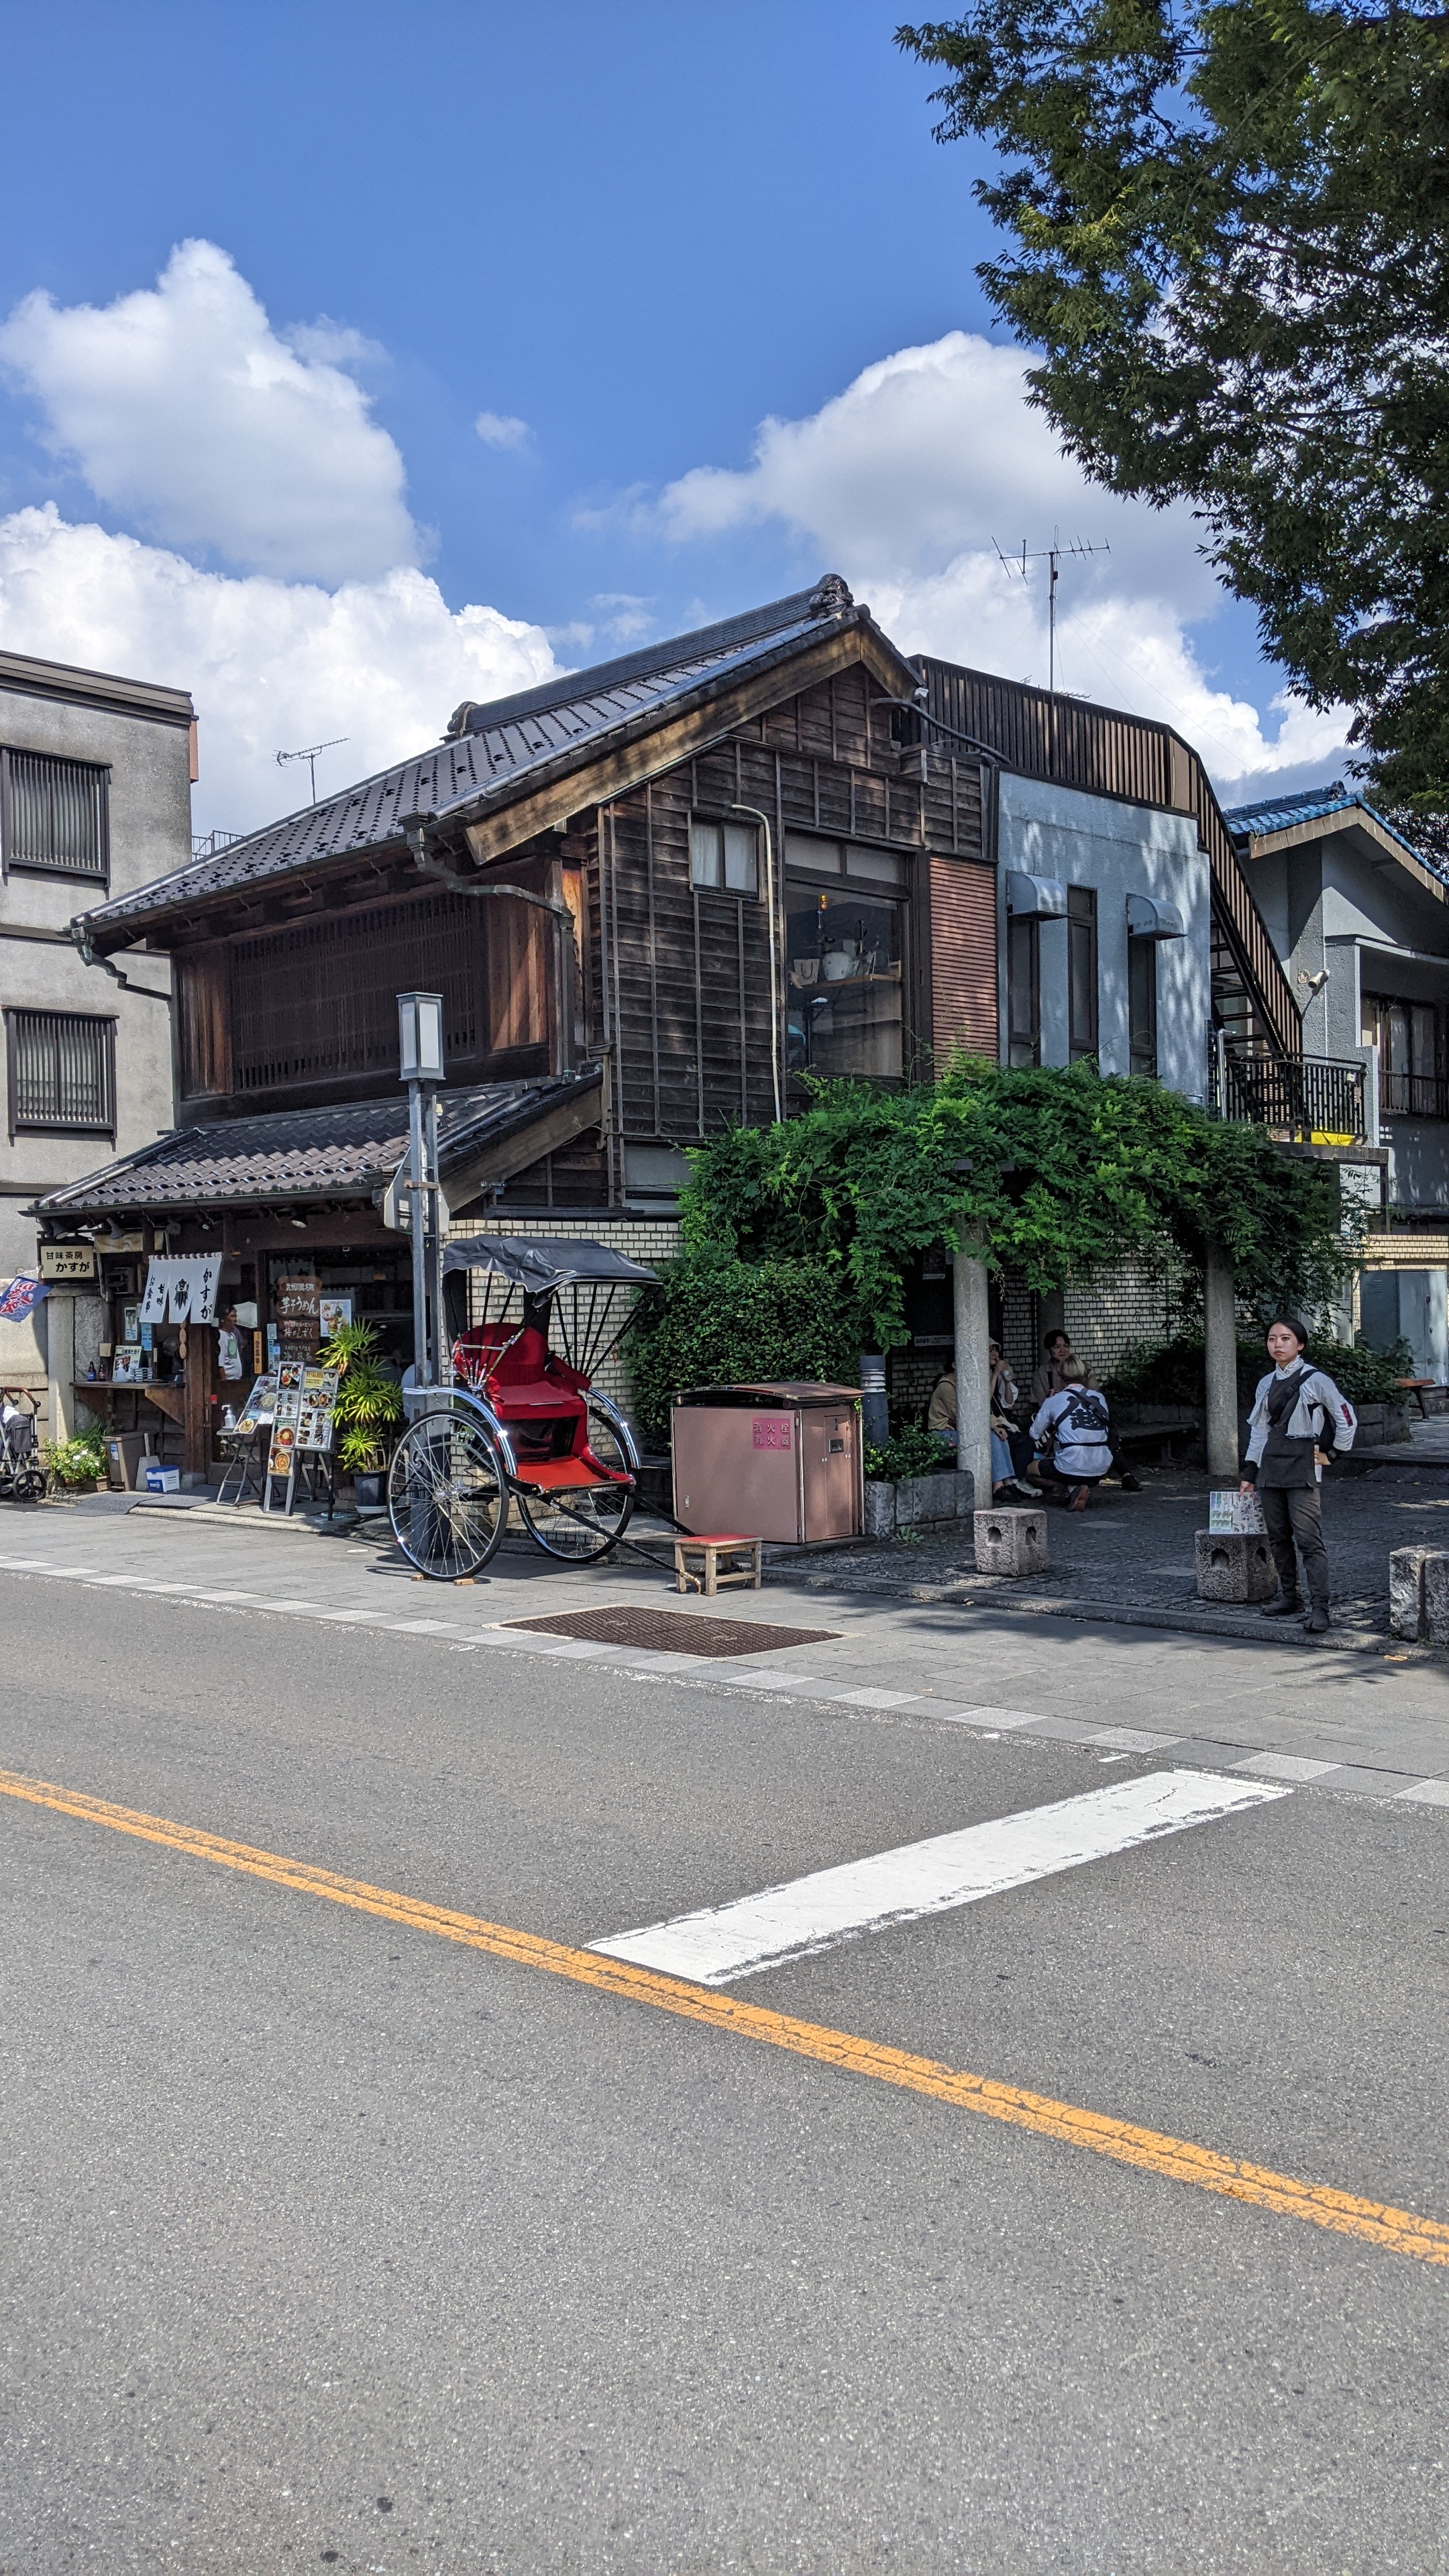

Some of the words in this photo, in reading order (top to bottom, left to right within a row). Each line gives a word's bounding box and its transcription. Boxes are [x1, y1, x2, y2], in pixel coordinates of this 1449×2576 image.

[46, 1251, 83, 1260] 甘味茶房
[56, 1262, 90, 1273] かすが
[201, 1268, 213, 1320] かすが
[280, 1296, 319, 1315] 芋そうめん
[753, 1422, 789, 1434] 消火栓
[754, 1436, 790, 1446] 消火器
